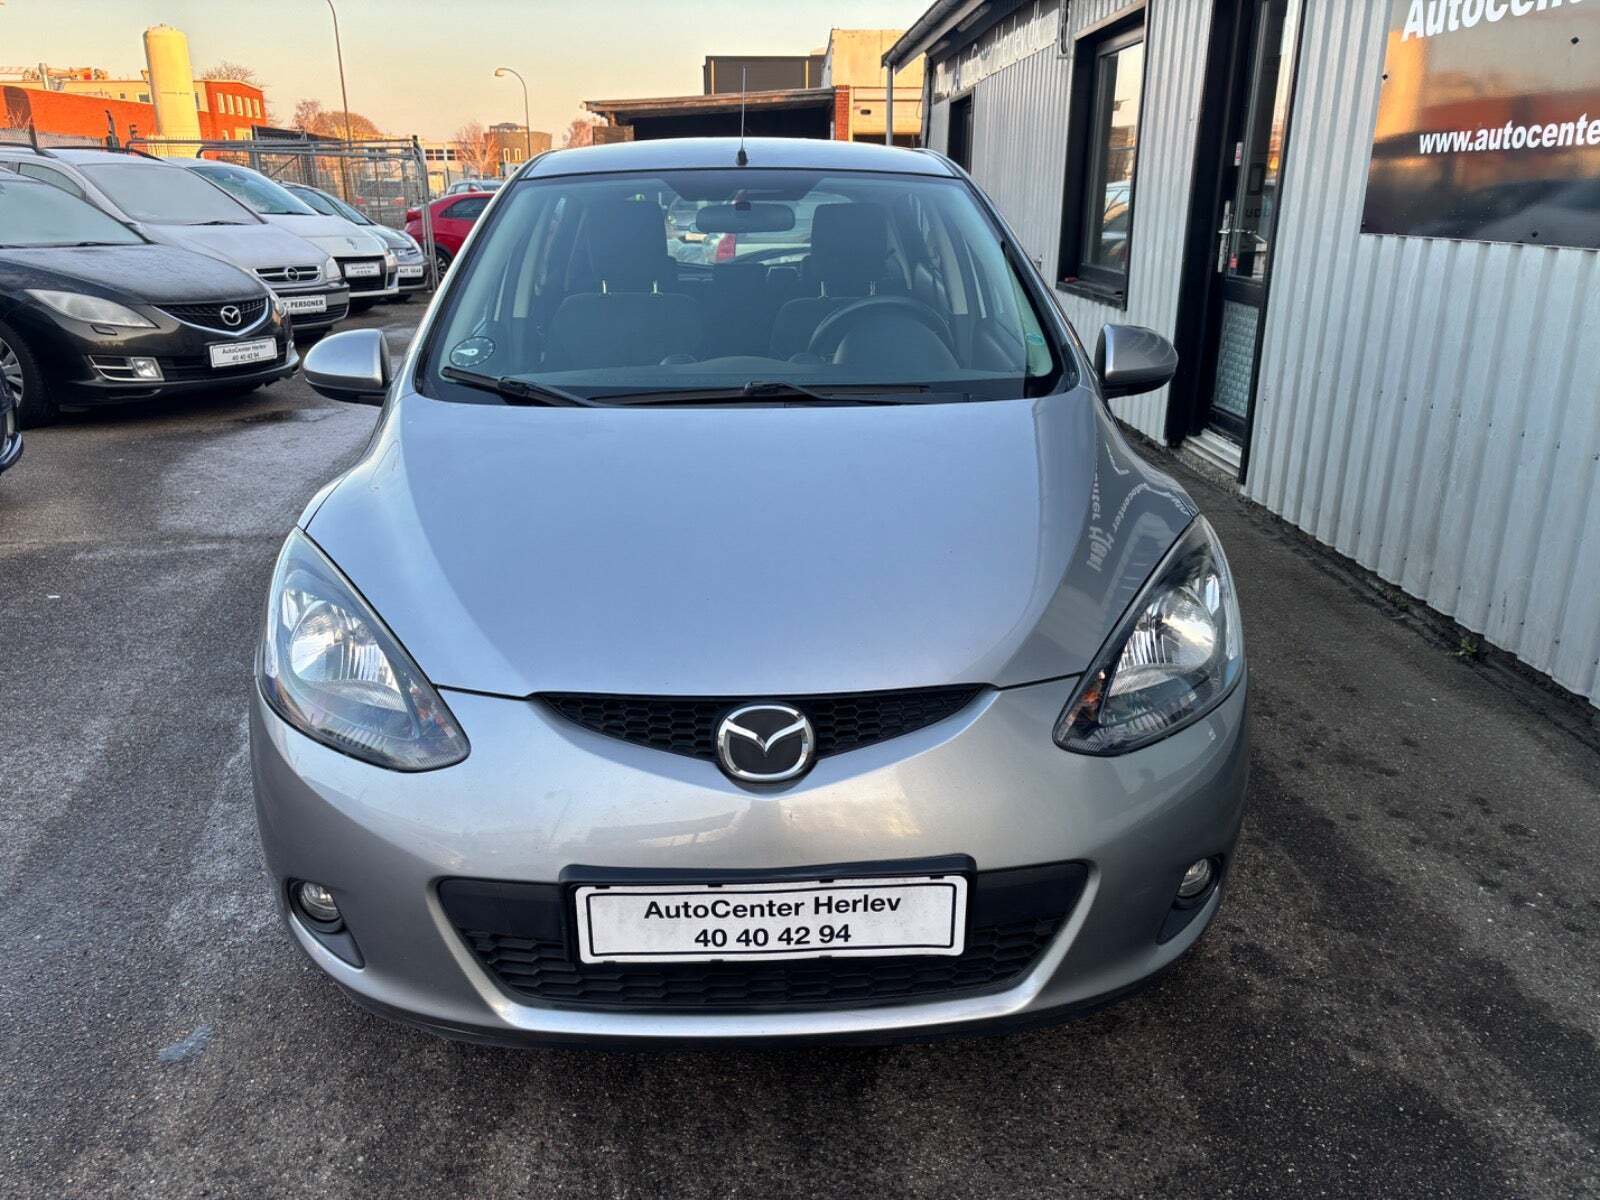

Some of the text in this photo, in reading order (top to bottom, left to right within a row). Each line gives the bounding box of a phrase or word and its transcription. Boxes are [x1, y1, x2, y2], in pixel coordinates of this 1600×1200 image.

[1419, 112, 1600, 154] www.autocente
[290, 299, 325, 308] PERSONER
[644, 894, 902, 919] AutoCenter Herlev
[694, 924, 852, 948] 40 40 42 94
